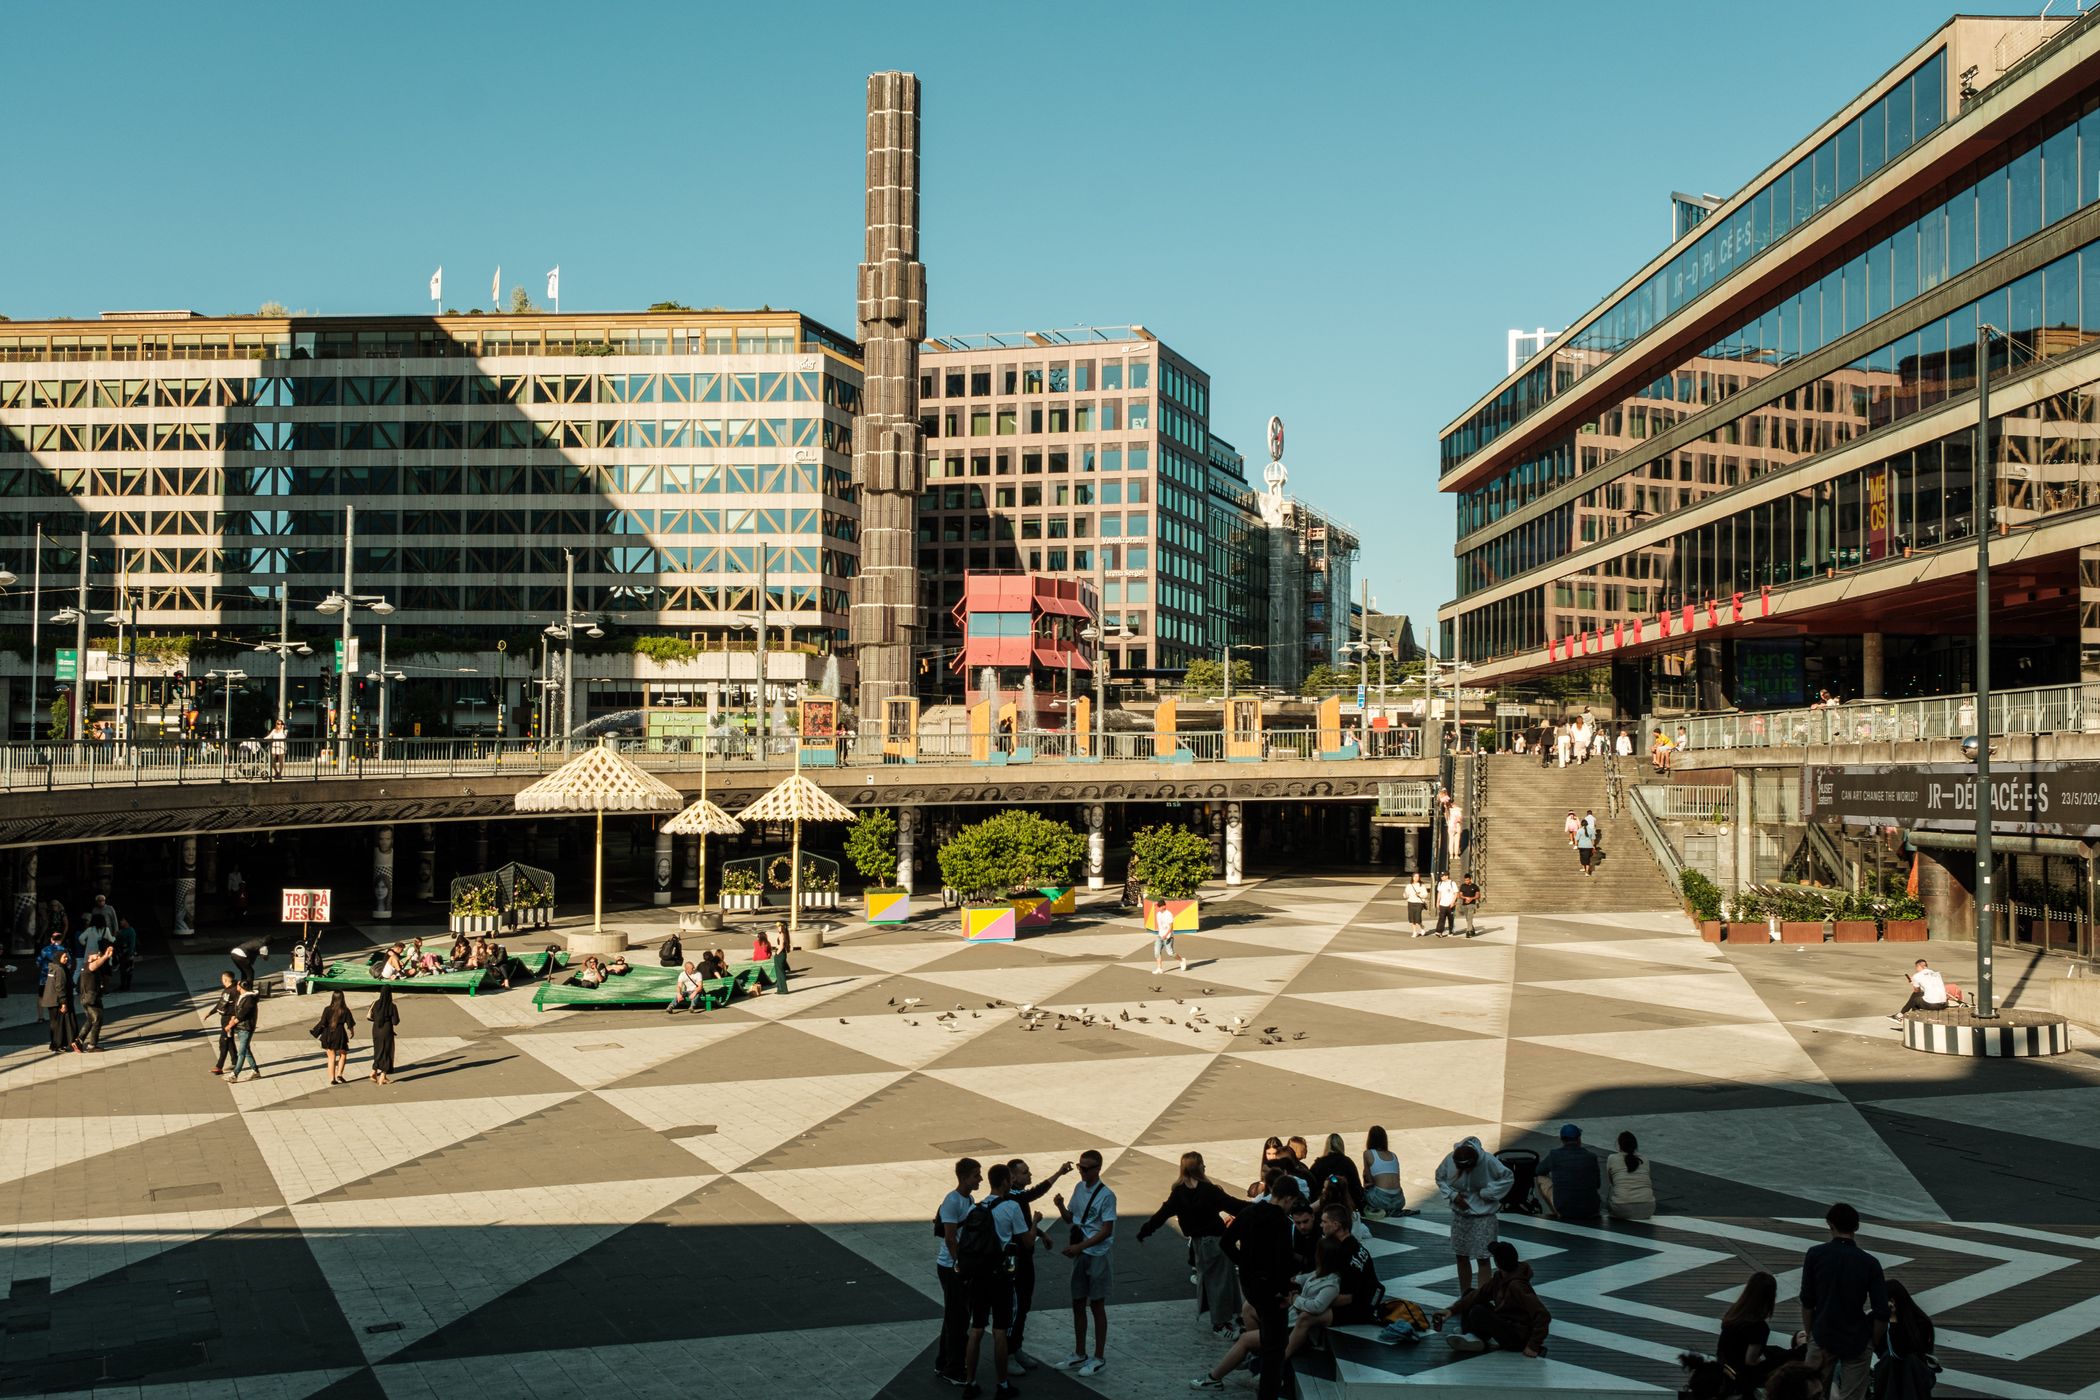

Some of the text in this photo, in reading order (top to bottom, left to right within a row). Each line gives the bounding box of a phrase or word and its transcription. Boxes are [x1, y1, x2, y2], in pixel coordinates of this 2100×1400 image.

[1132, 417, 1147, 430] EY
[1841, 790, 1852, 800] CAN
[1852, 790, 1862, 801] ART
[1863, 790, 1884, 801] CHANGE
[1885, 791, 1895, 802] THE
[1896, 791, 1918, 802] WORLD?
[285, 889, 328, 907] TRO PÅ
[285, 907, 327, 921] JESUS.
